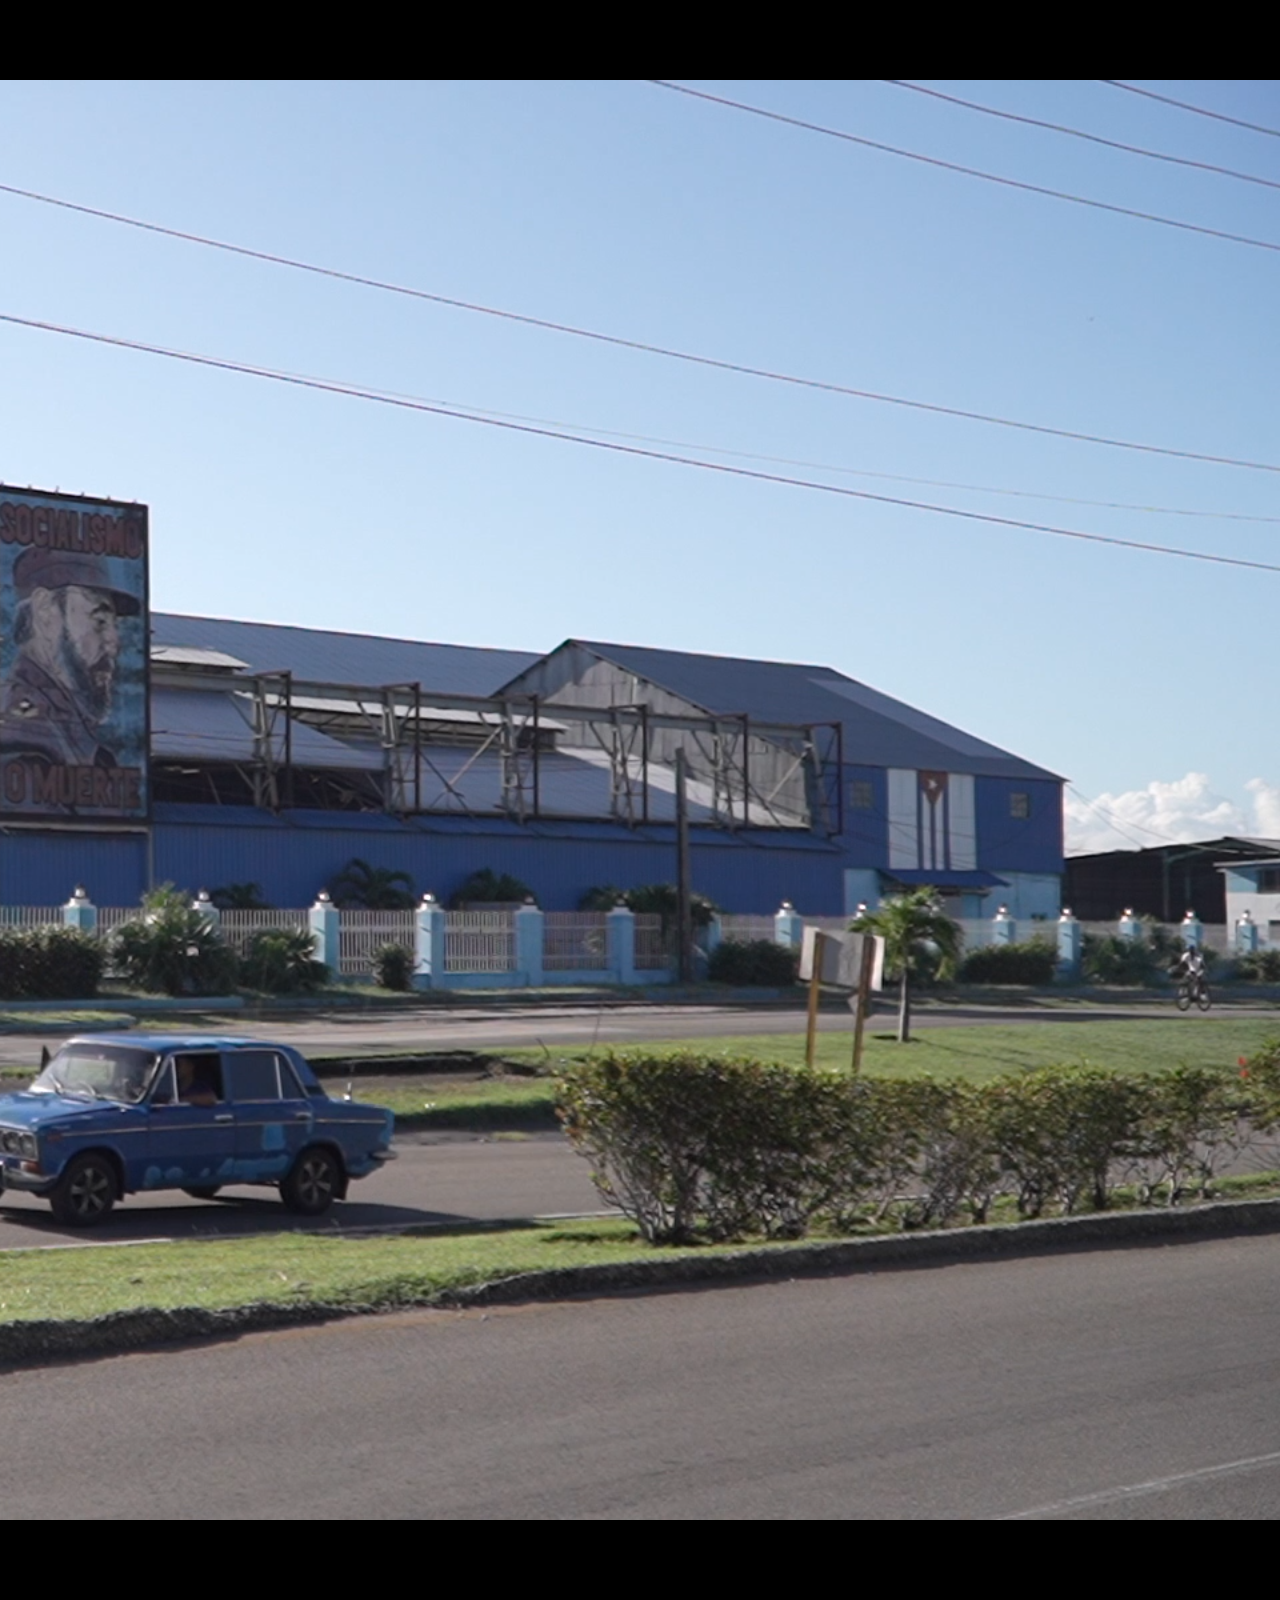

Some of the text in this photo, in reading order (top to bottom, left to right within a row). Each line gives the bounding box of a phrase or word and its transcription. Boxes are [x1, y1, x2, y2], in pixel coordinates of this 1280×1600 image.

[0, 501, 142, 559] SOCIALISMO
[4, 761, 141, 809] O MUERTE
